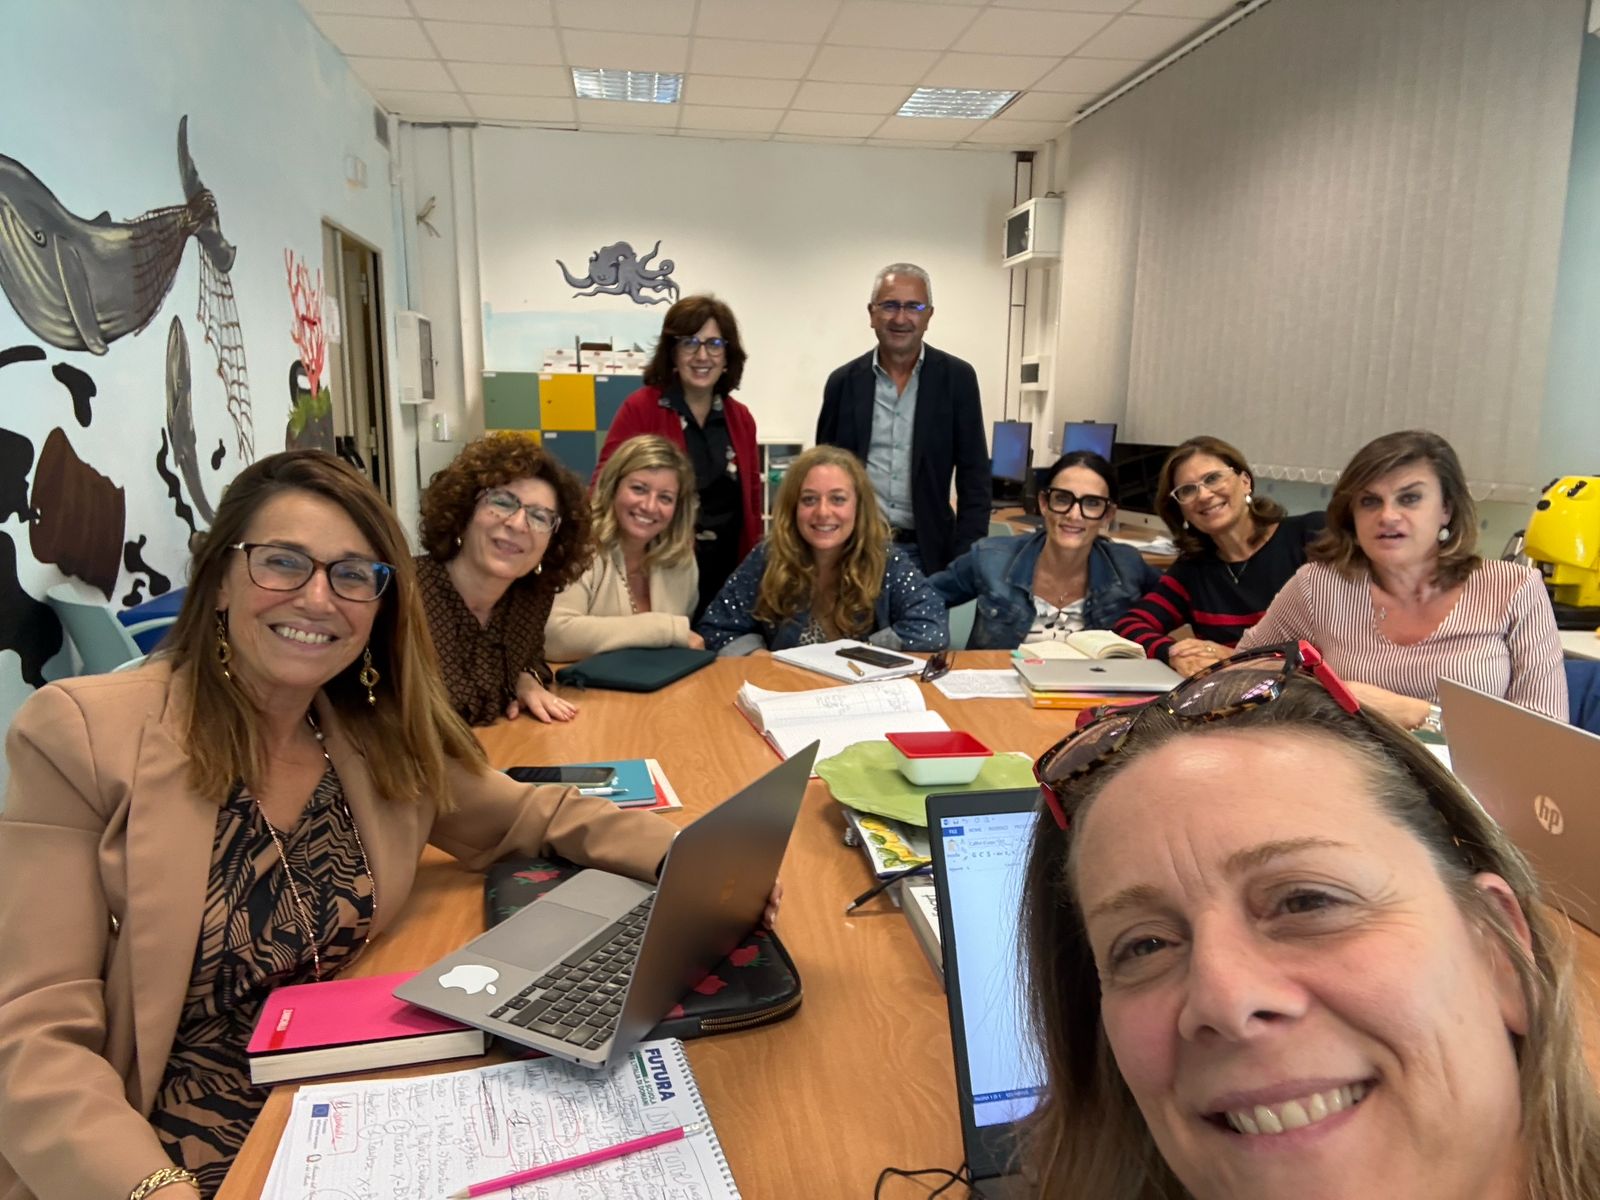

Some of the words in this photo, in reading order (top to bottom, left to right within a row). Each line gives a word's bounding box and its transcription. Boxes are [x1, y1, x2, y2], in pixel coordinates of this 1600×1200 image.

[1538, 796, 1561, 834] hp
[645, 1048, 676, 1101] FUTURA
[638, 1085, 649, 1106] DOMANI
[646, 1083, 657, 1105] SCUOLA
